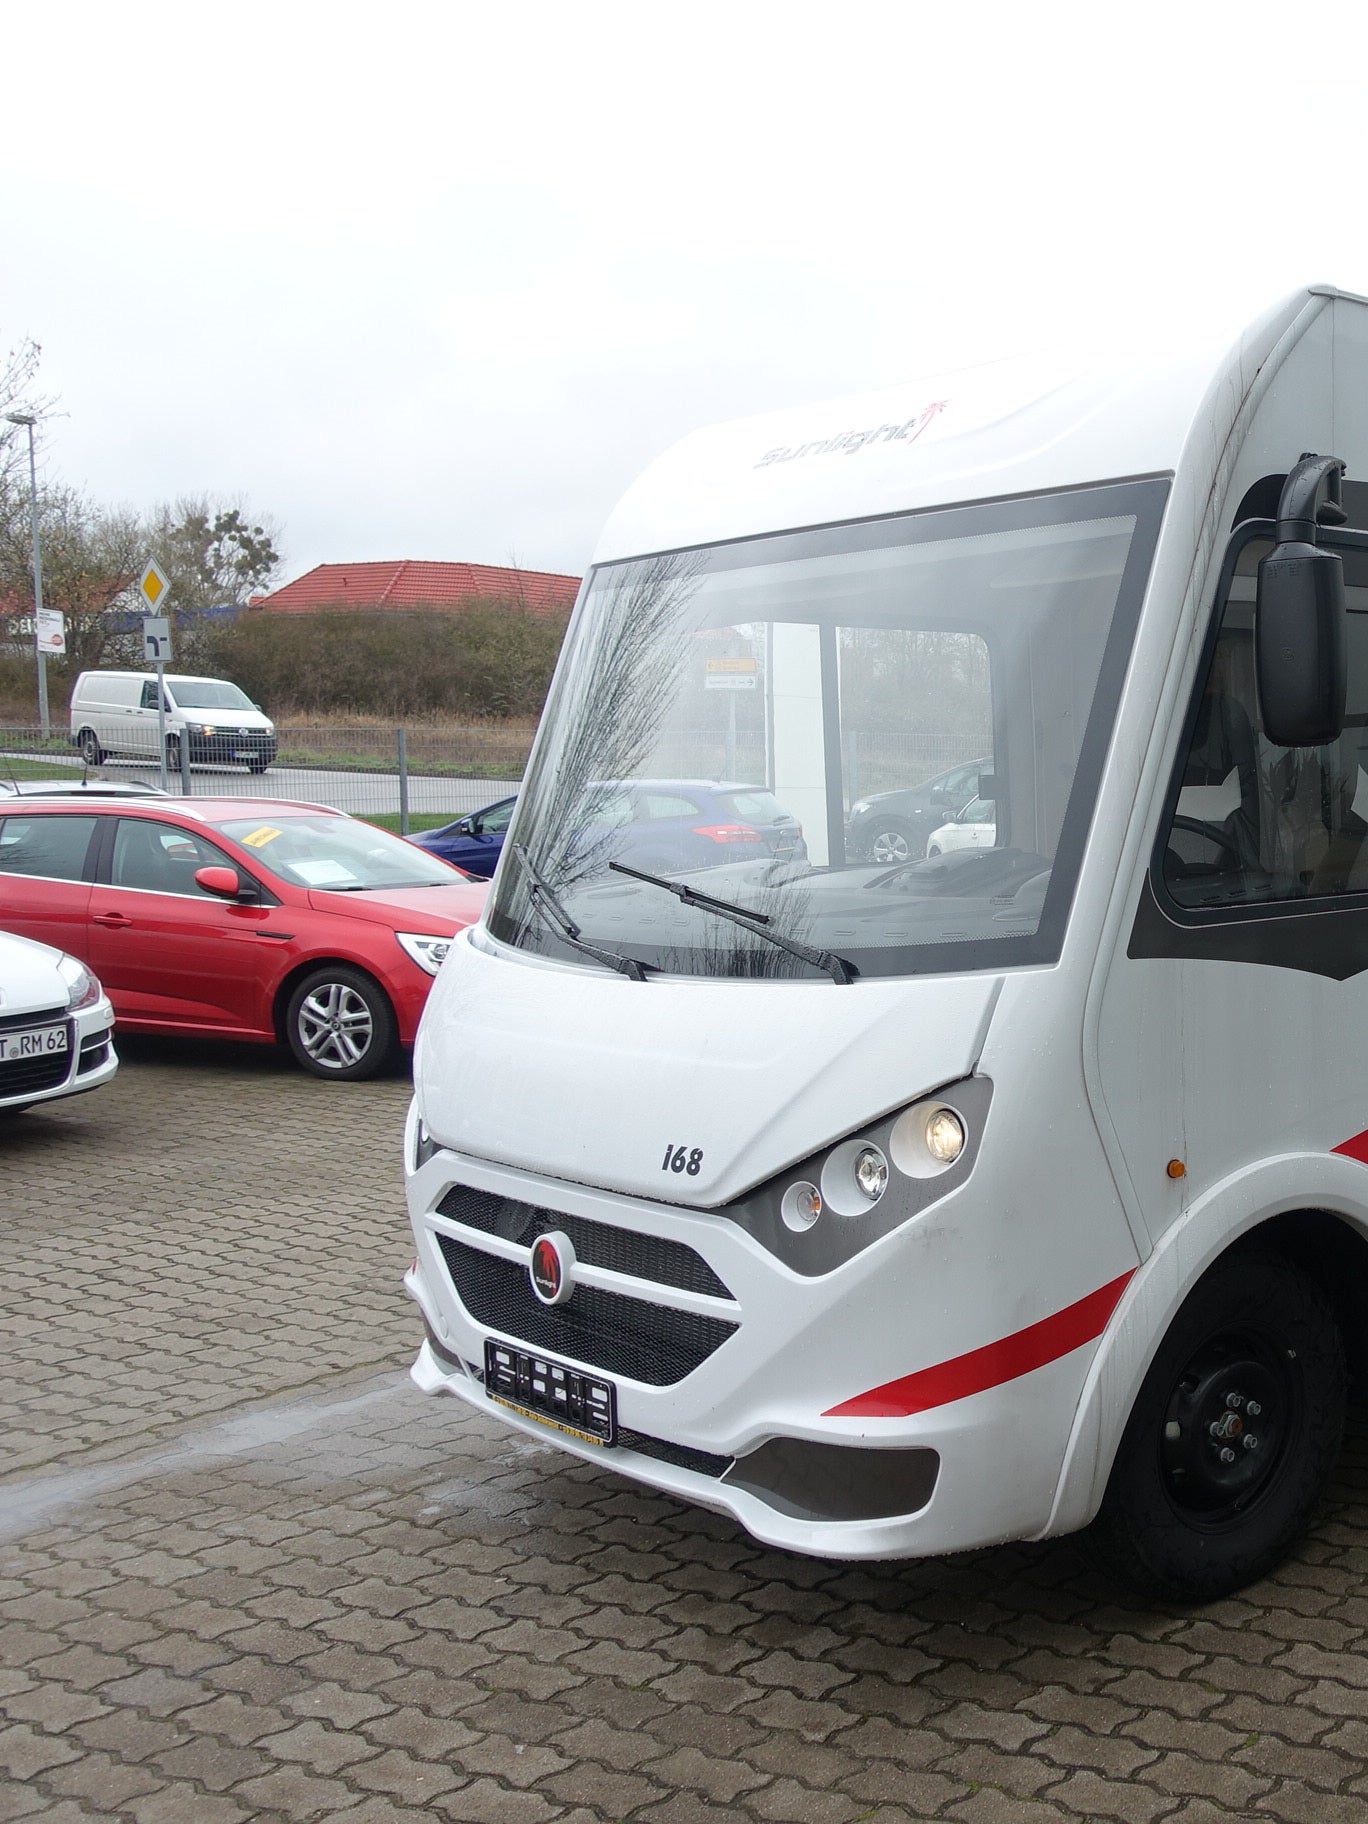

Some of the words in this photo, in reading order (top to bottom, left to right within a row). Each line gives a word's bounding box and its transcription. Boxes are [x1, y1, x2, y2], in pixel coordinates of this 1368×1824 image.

[20, 1034, 43, 1056] RM
[46, 1030, 66, 1050] 62
[662, 1144, 704, 1176] i68
